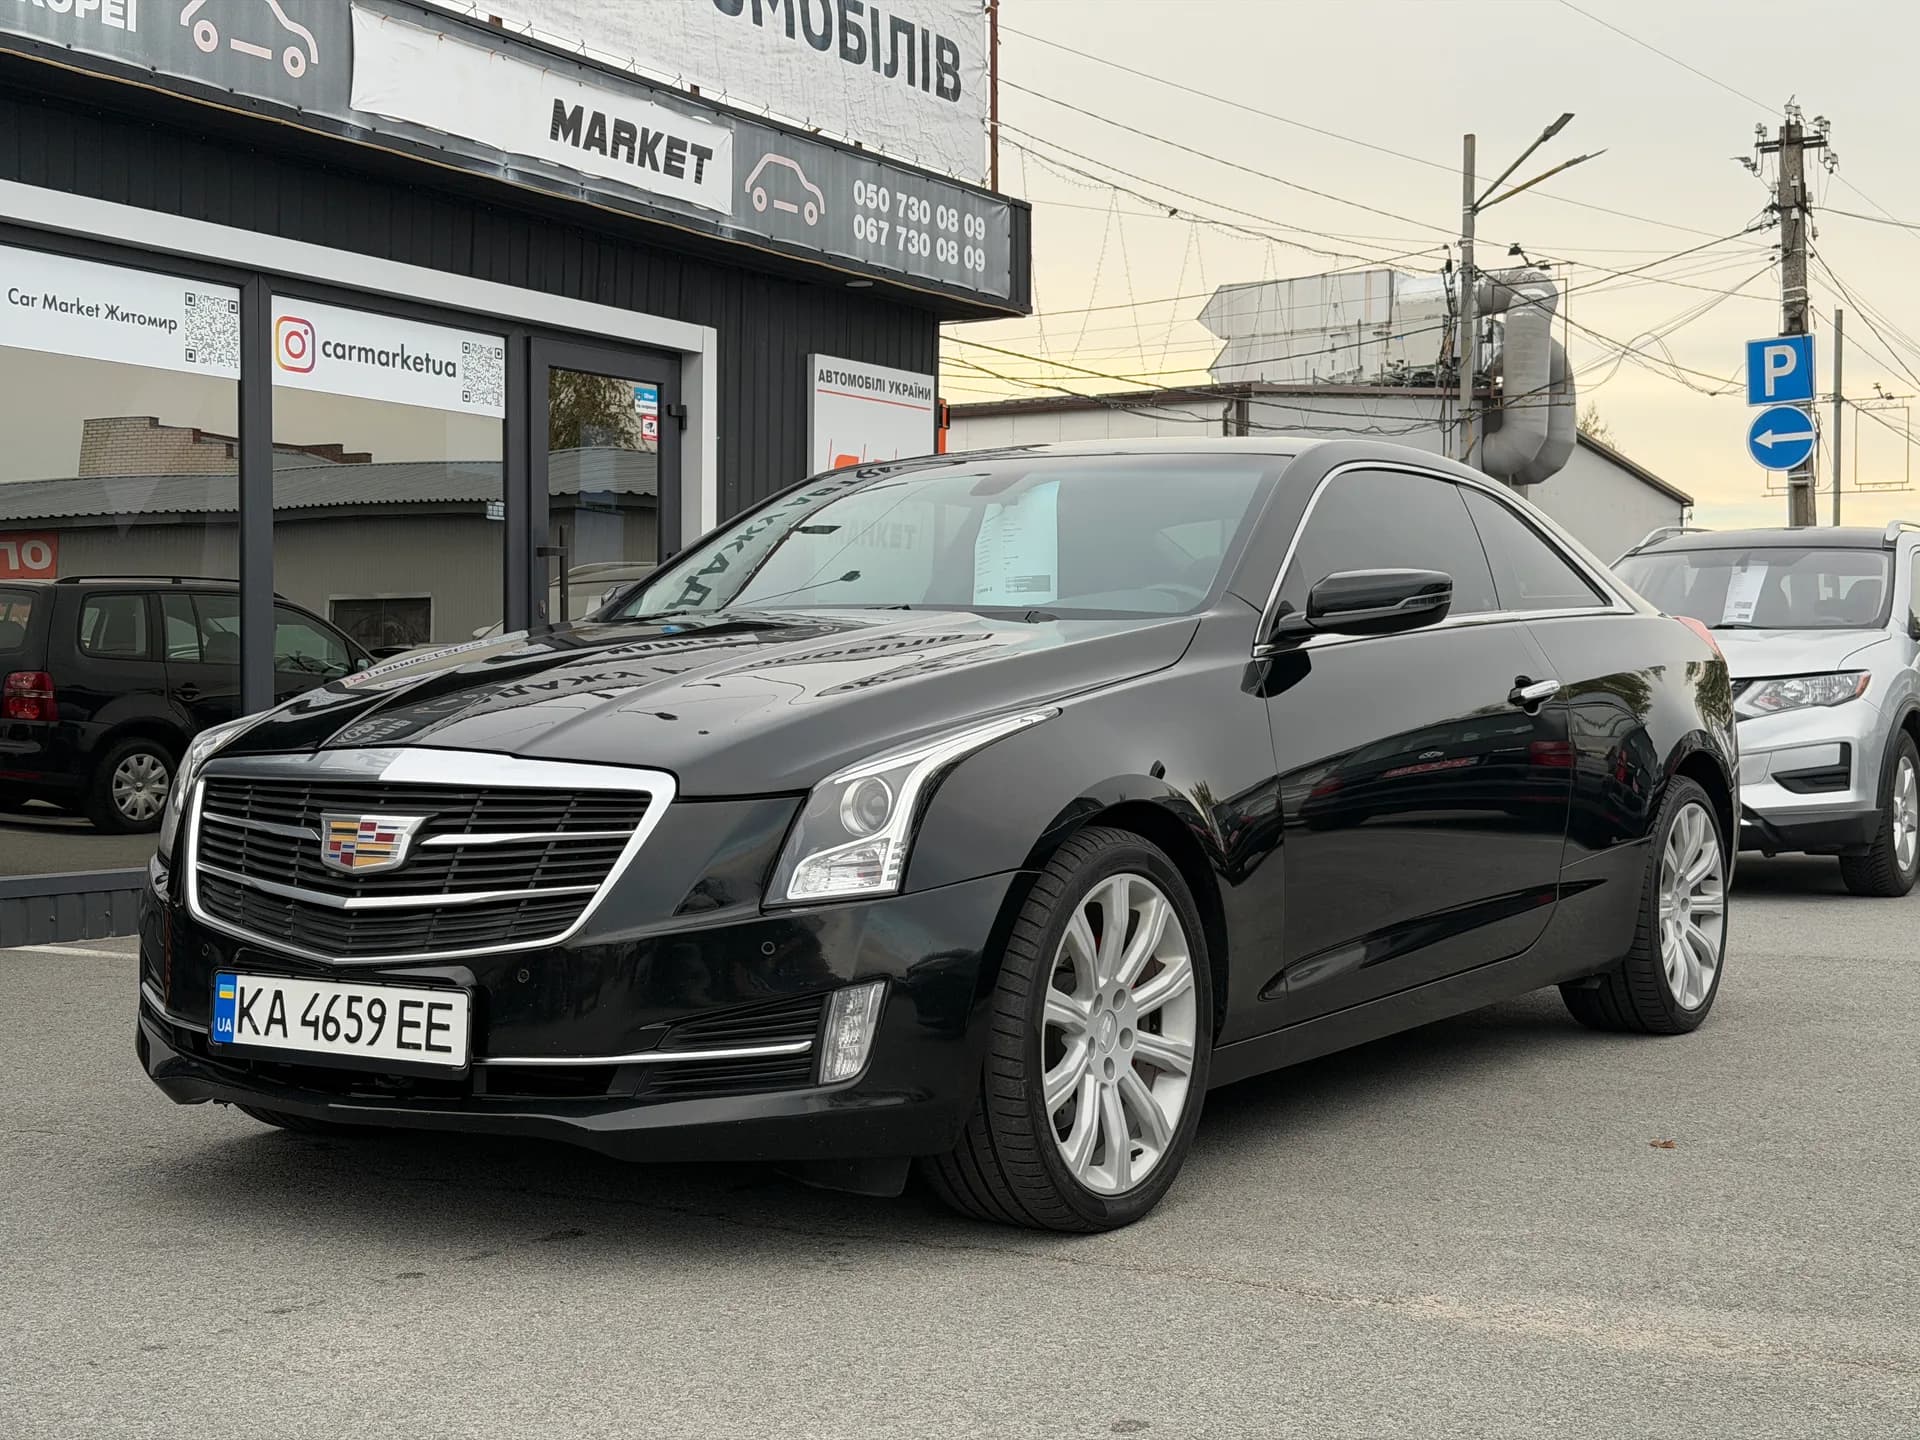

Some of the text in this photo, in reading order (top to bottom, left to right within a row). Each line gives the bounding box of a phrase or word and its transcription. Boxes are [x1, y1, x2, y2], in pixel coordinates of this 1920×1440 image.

[712, 0, 962, 103] ОБІЛІВ
[549, 98, 713, 185] MARKET
[853, 179, 986, 241] 050 730 08 09
[853, 213, 986, 272] 067 730 08 09
[7, 287, 178, 335] Car Market Житомир
[321, 339, 457, 378] carmarketua
[818, 369, 931, 400] АВТОМОБІЛІ УКРАЇНИ
[1764, 345, 1797, 396] P
[217, 1017, 232, 1033] UA
[237, 986, 453, 1053] KA 4659 EE
